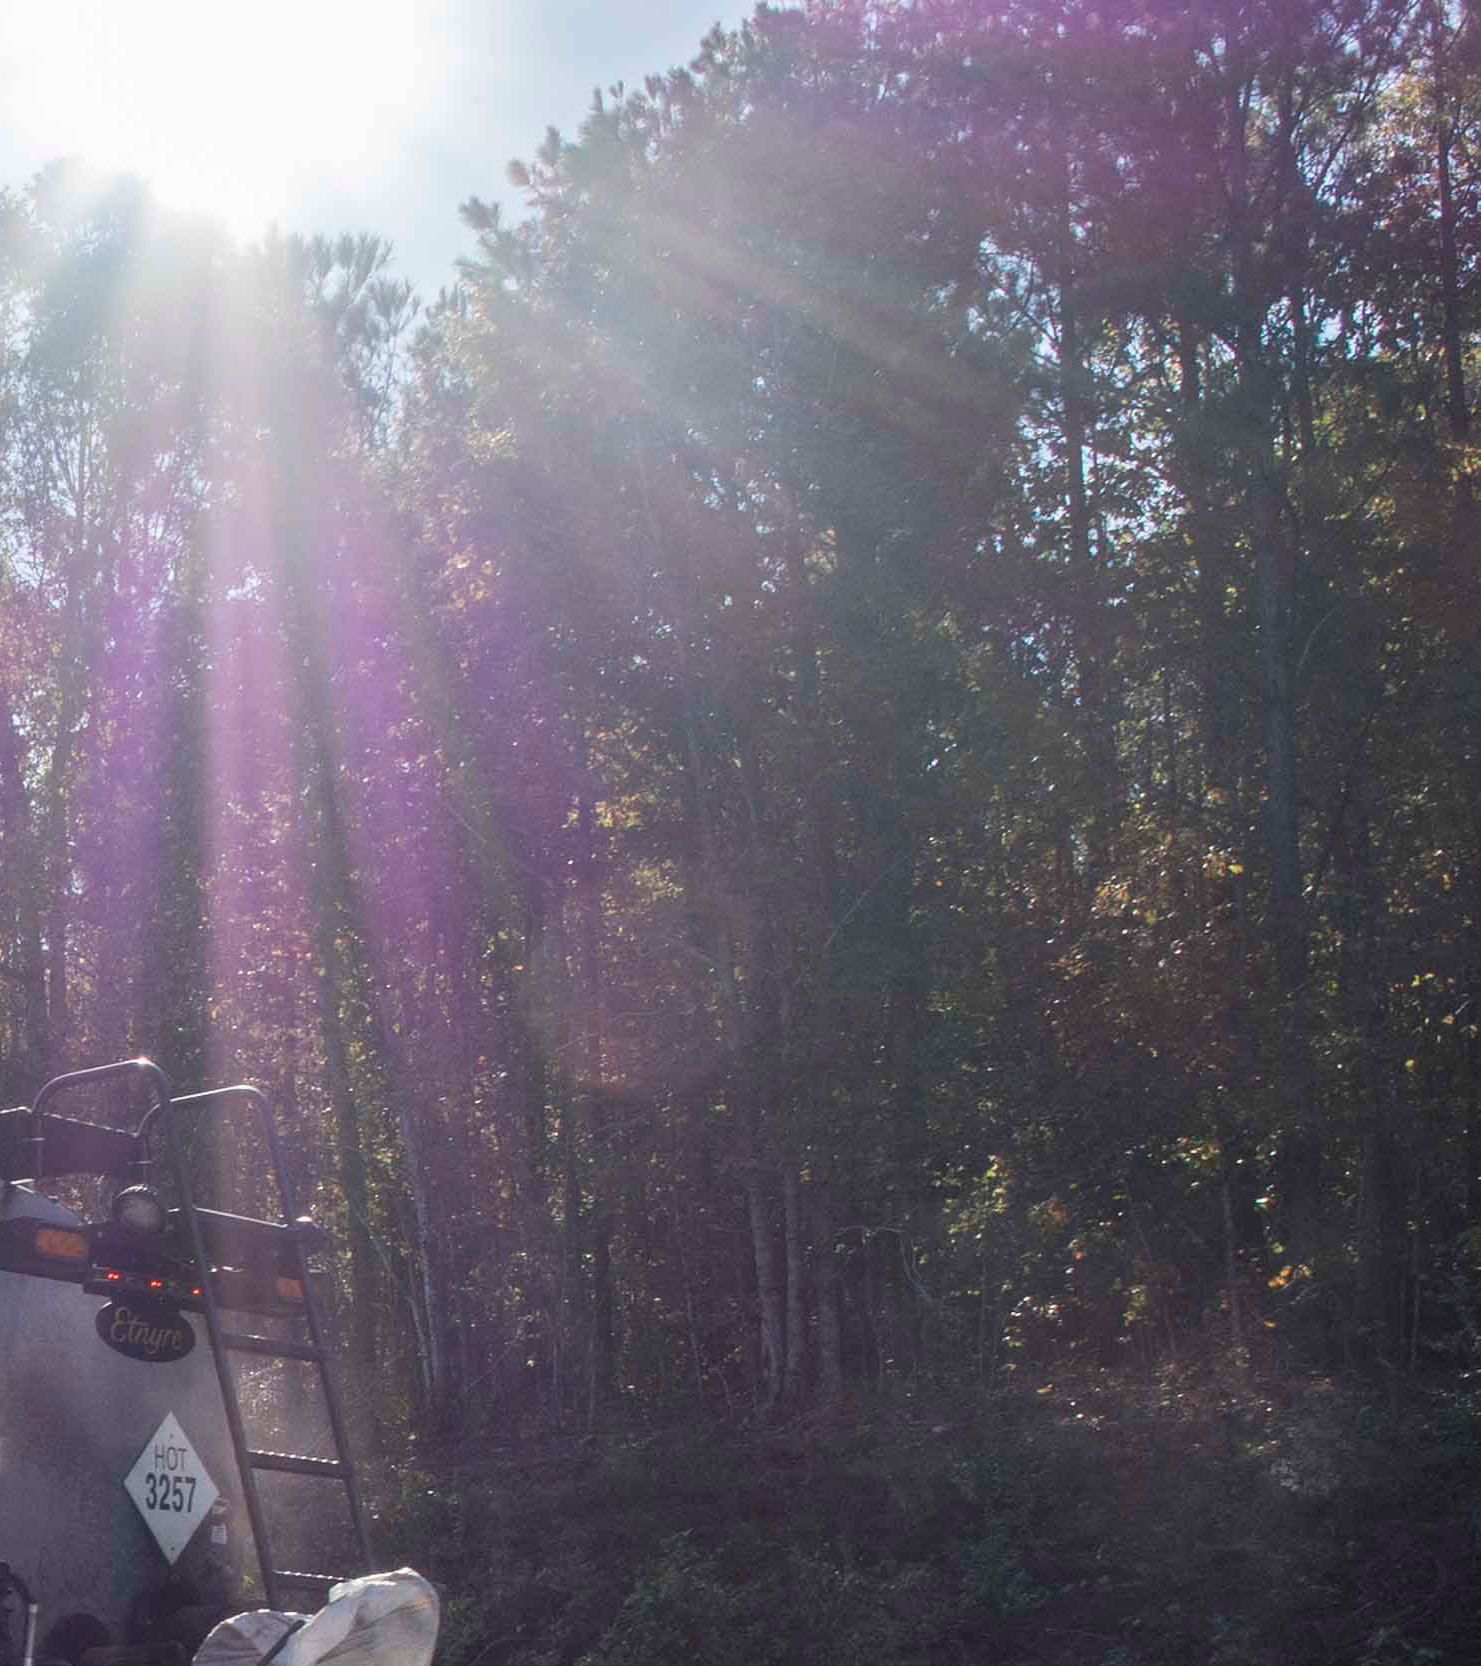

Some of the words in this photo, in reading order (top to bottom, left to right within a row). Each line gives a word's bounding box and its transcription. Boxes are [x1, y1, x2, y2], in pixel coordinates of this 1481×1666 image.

[110, 1306, 182, 1354] Etnyre
[154, 1444, 187, 1472] HOT
[145, 1472, 197, 1513] 3257
